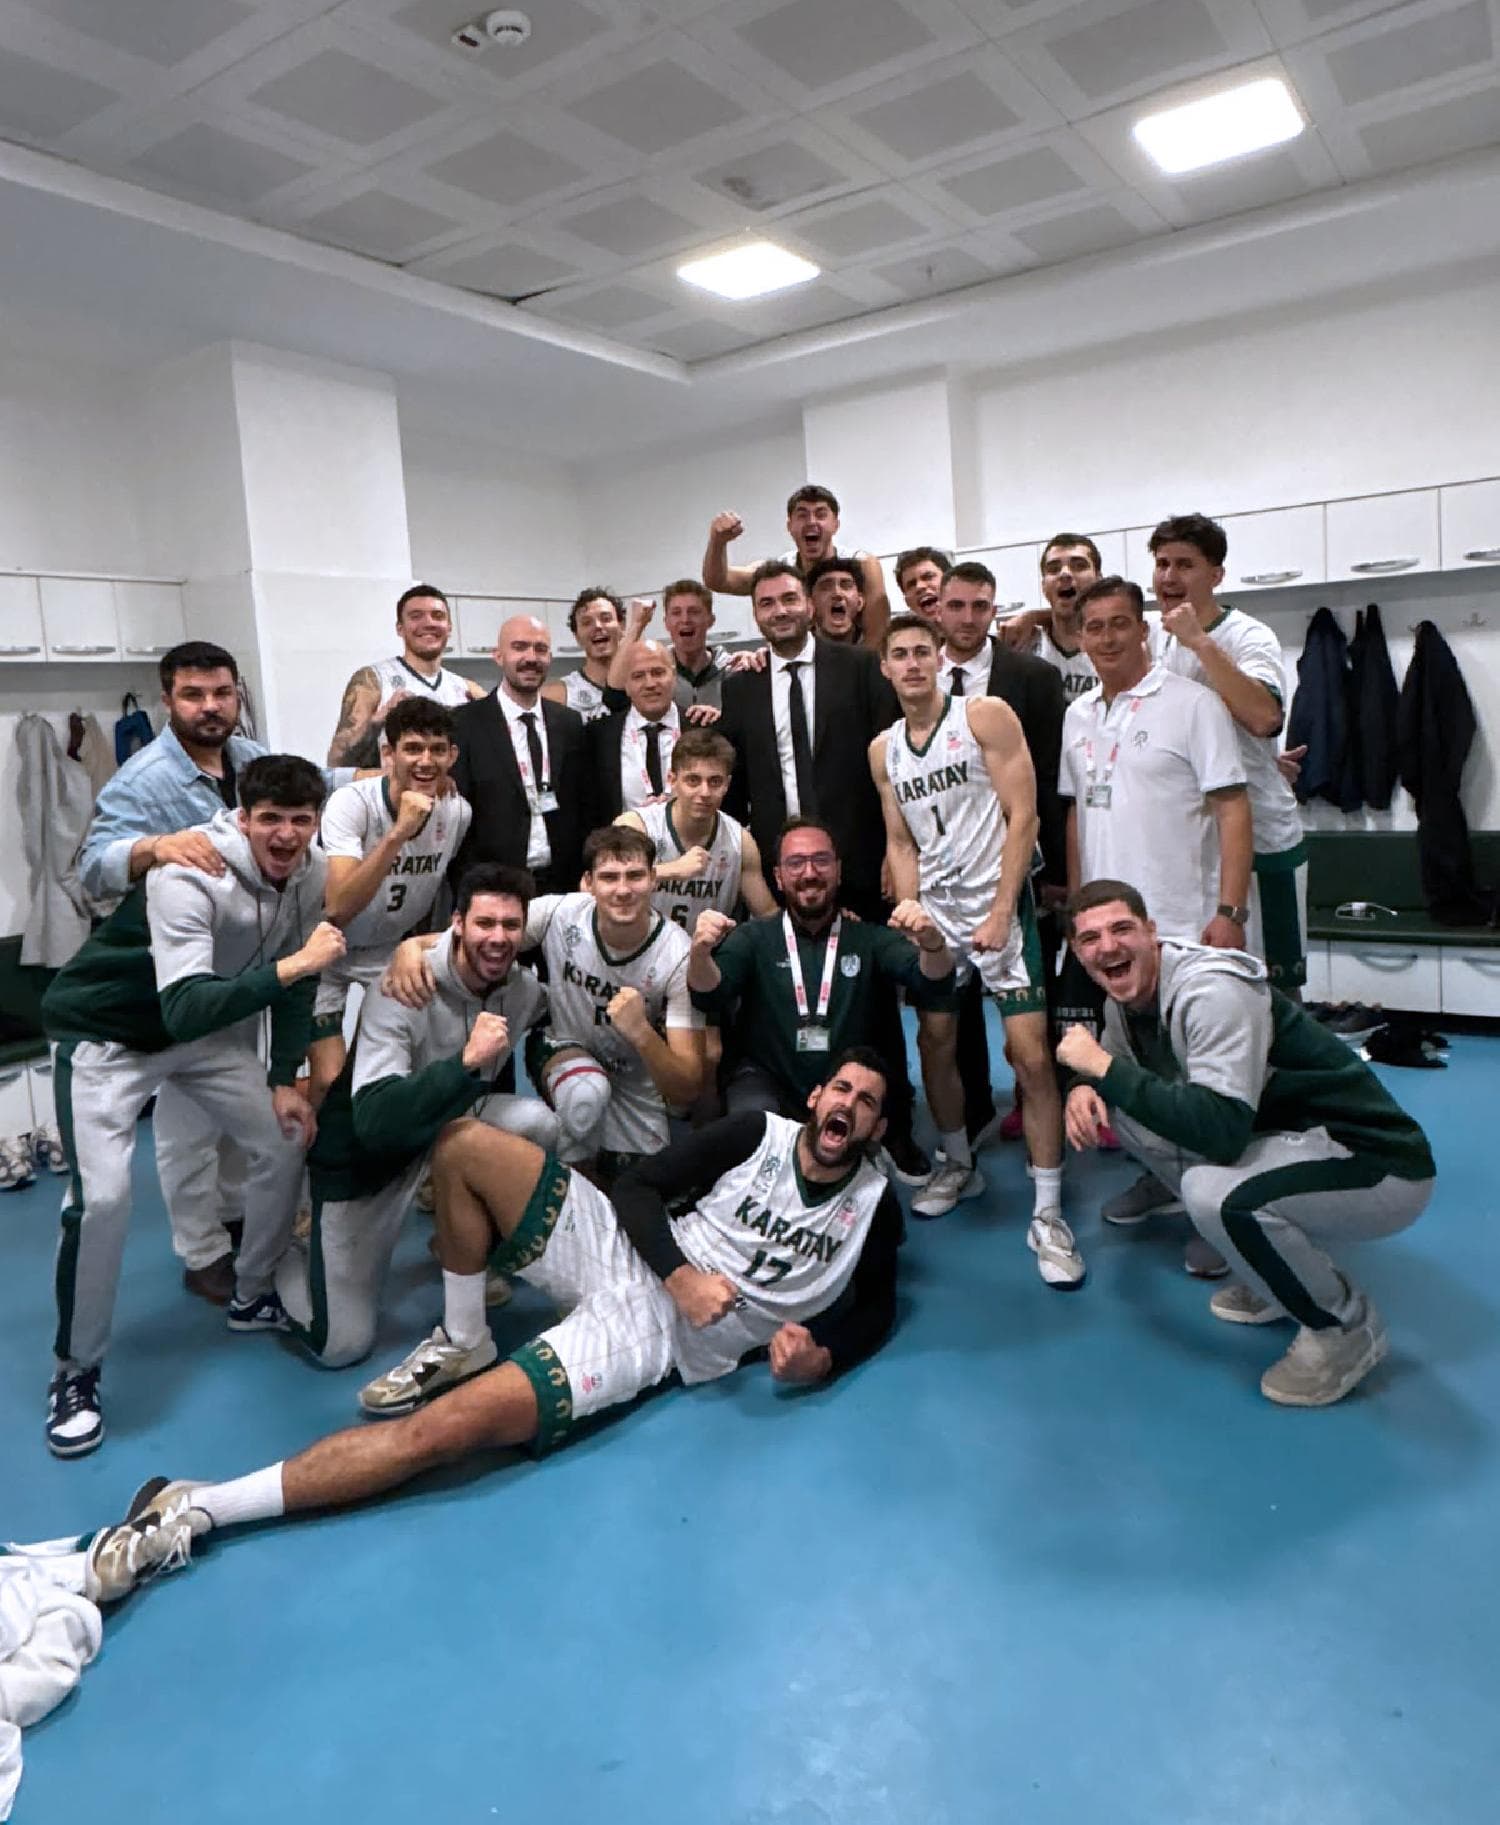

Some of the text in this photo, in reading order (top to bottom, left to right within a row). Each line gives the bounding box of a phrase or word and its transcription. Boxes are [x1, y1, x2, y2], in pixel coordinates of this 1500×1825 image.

[931, 805, 946, 836] 1
[391, 852, 443, 876] RATAY
[387, 884, 407, 912] 3
[656, 879, 724, 898] ARATAY
[735, 1195, 842, 1263] KARATAY
[742, 1250, 793, 1287] 17
